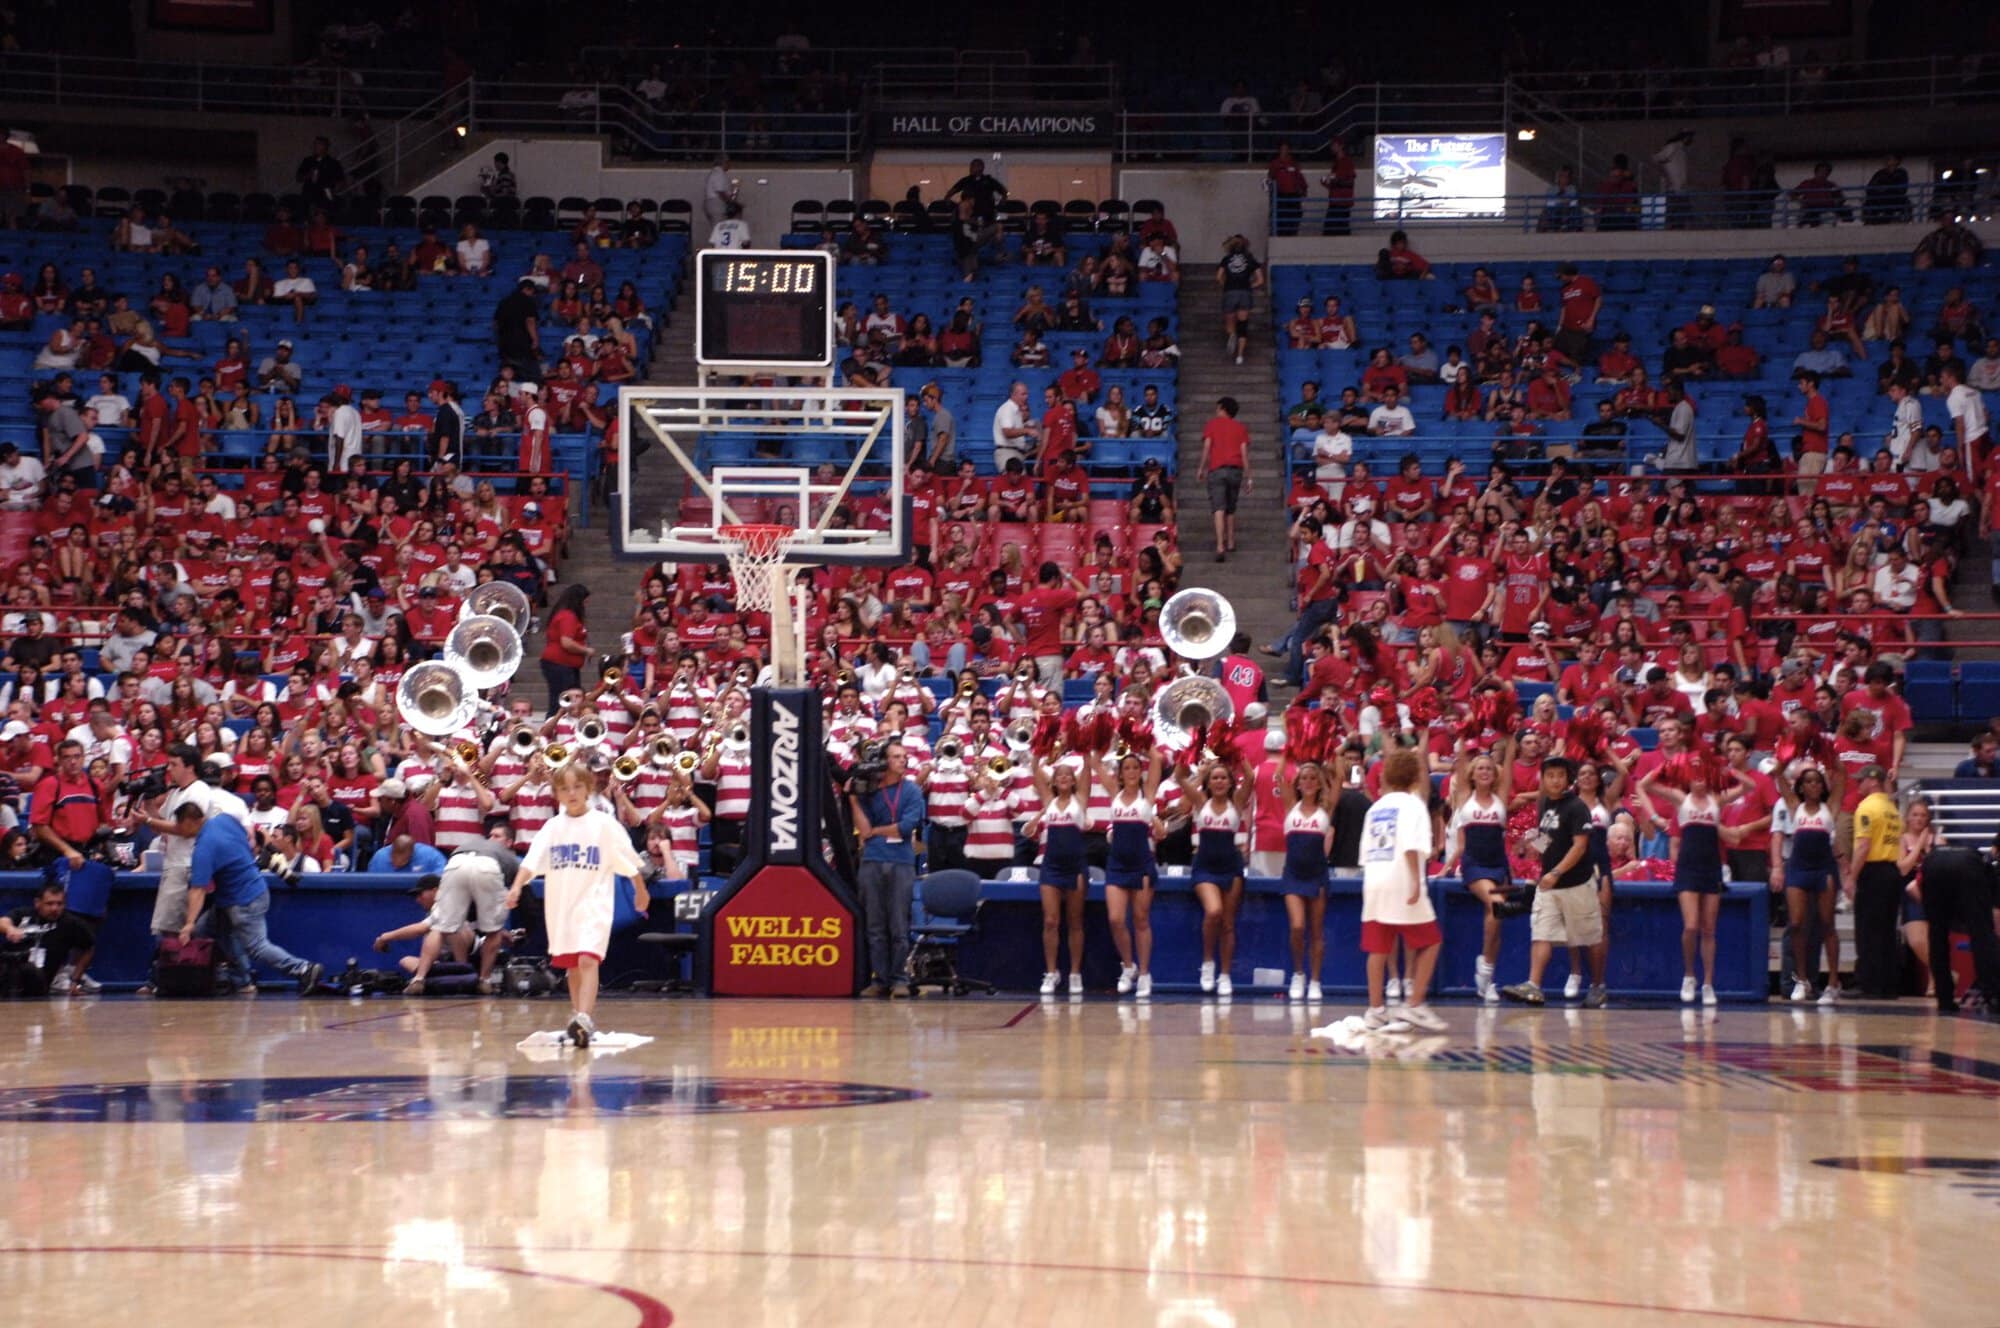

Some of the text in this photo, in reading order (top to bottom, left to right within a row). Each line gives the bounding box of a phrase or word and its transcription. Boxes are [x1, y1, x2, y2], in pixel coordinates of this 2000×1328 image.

[892, 117, 1096, 133] HALL OF CHAMPIONS
[1404, 139, 1428, 153] The
[725, 263, 815, 293] 15:00
[1229, 664, 1255, 688] 43
[771, 700, 799, 854] ARIZONA
[726, 916, 842, 939] WELLS
[729, 943, 840, 966] FARGO
